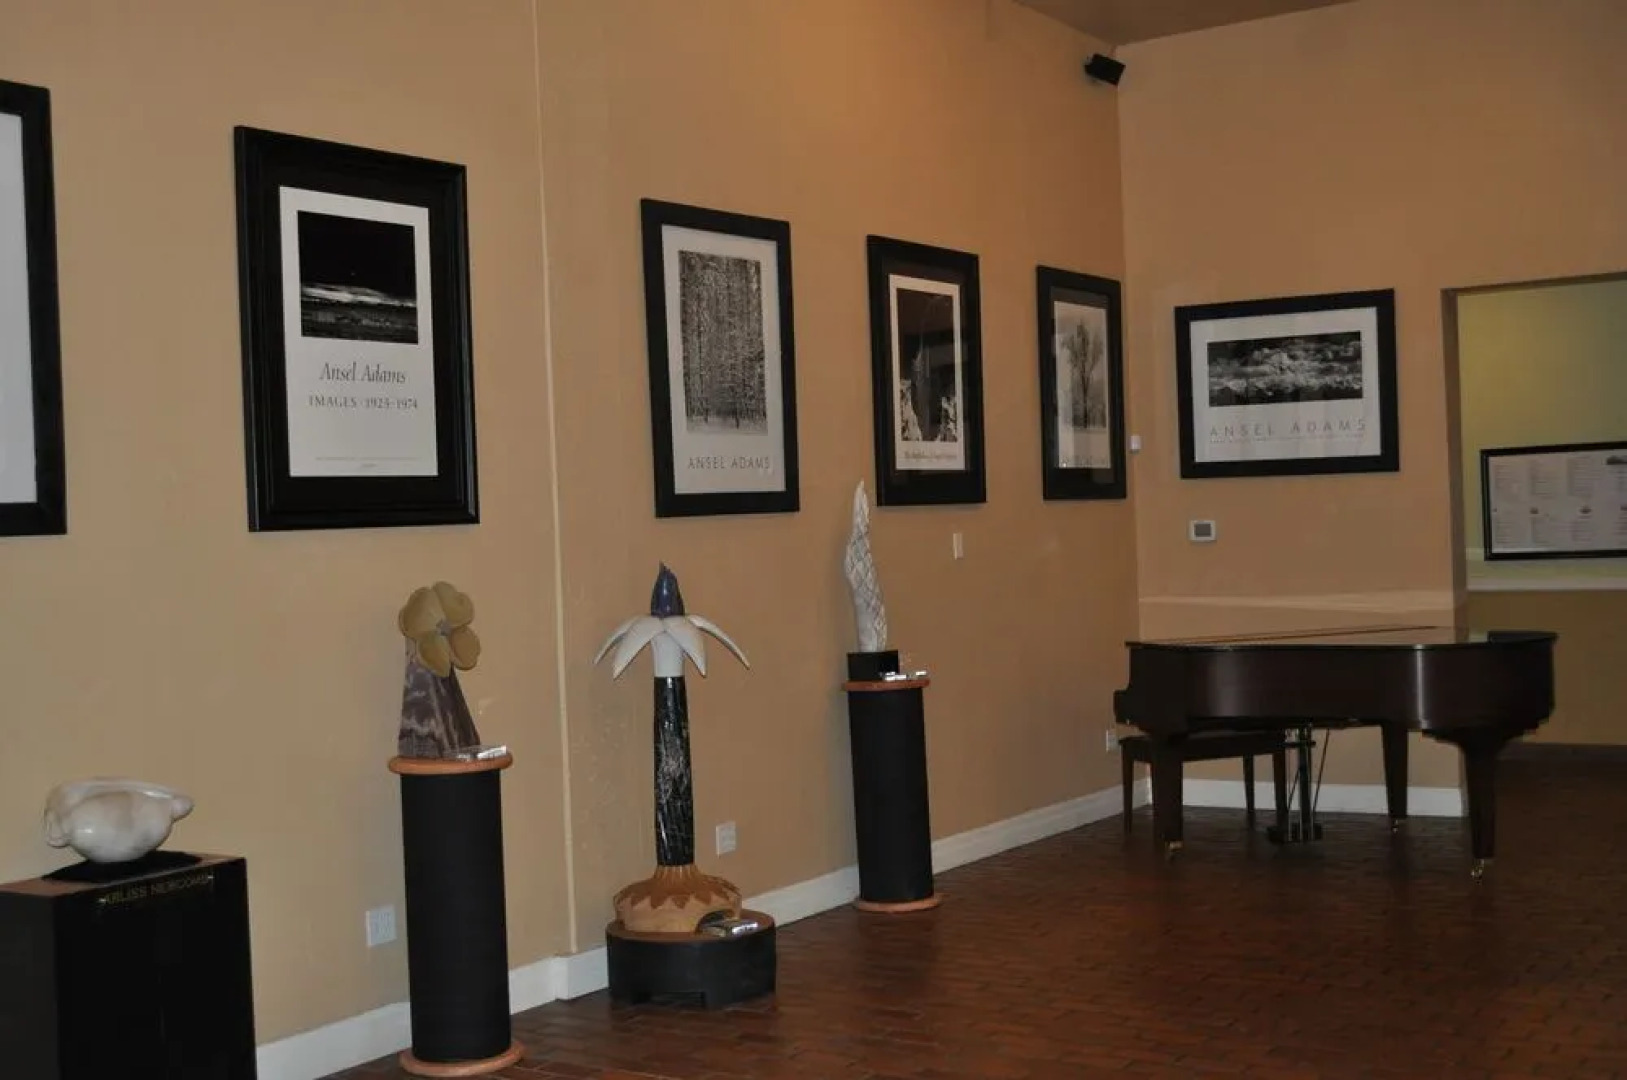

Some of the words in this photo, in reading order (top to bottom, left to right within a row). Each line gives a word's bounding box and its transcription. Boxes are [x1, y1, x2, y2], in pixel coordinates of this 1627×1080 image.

[319, 360, 357, 381] Ansel
[361, 363, 406, 383] Adams
[308, 394, 357, 408] IMAGES
[1209, 422, 1275, 437] ANSEL
[1289, 418, 1366, 434] ADAMS
[688, 456, 725, 469] ANSEL
[731, 456, 770, 469] ADAMS
